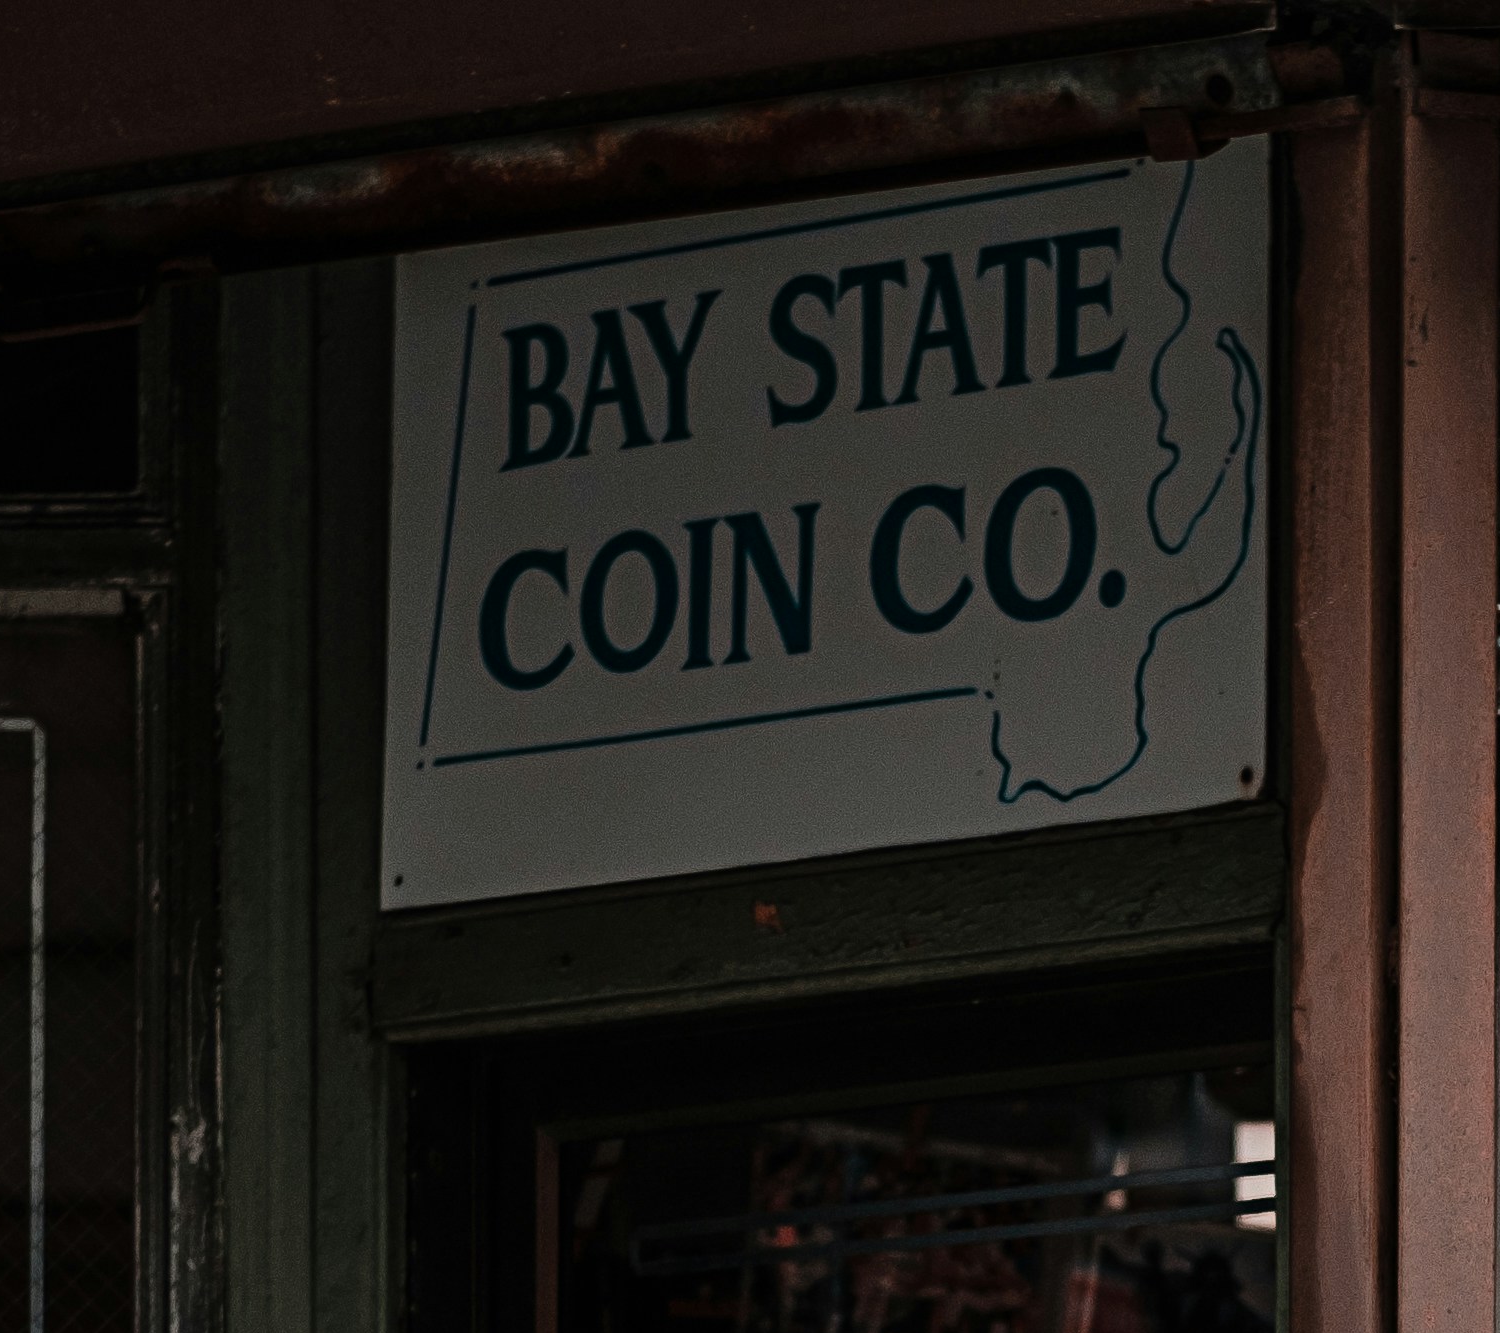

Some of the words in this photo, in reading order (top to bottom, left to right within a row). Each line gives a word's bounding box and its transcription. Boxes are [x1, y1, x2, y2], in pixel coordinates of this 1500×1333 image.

[500, 289, 722, 472] BAY
[766, 227, 1129, 427] STATE
[478, 503, 822, 690] COIN
[869, 466, 1127, 635] CO.
